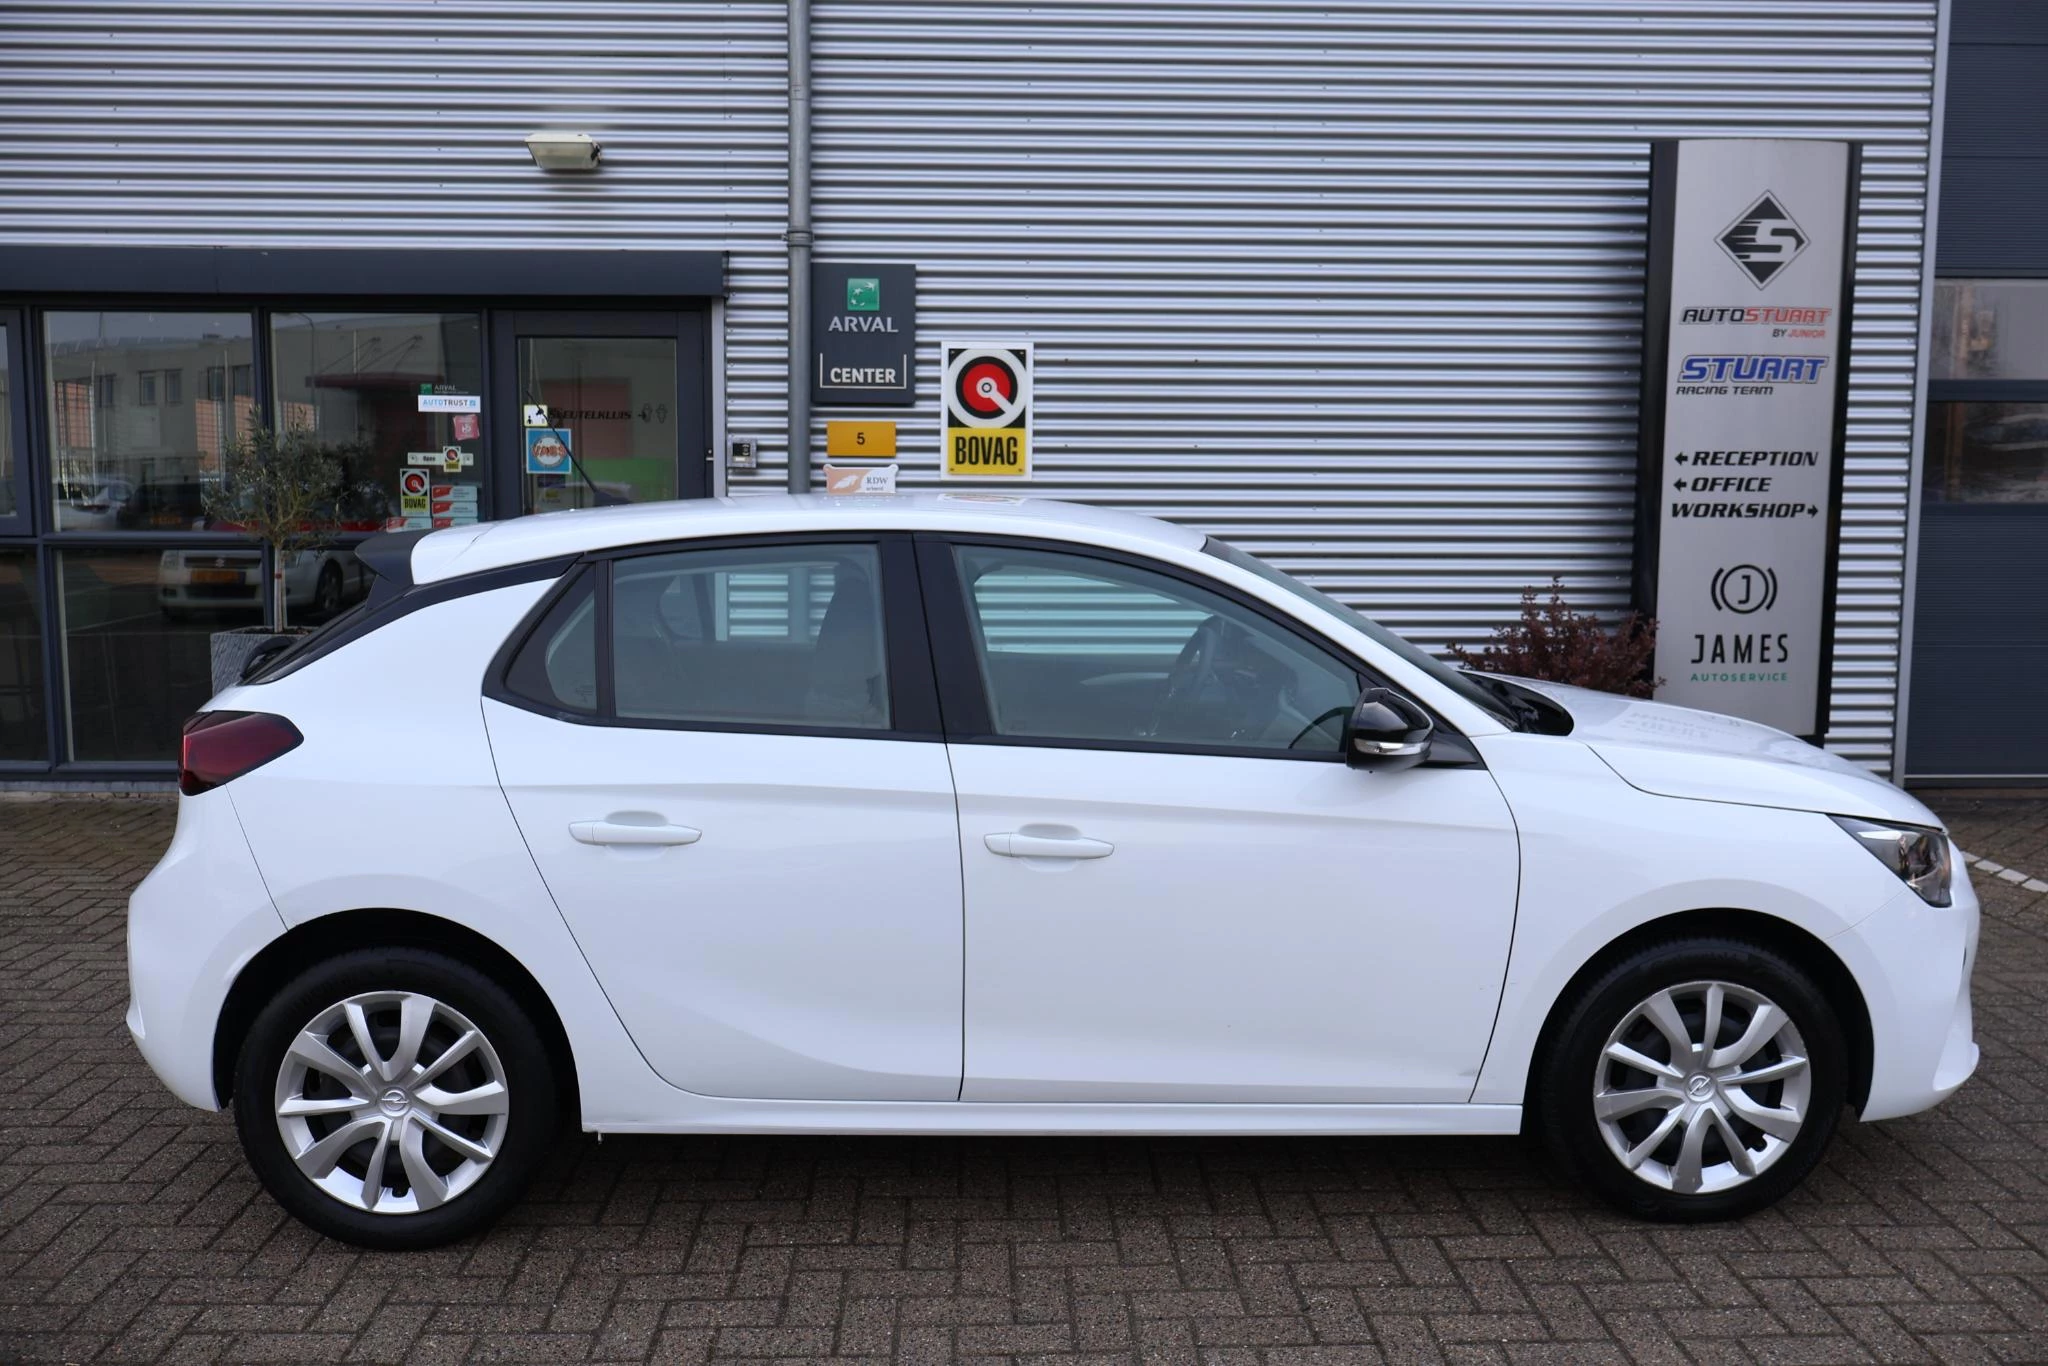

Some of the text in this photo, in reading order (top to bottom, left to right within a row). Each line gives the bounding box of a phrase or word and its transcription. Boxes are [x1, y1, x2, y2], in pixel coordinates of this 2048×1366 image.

[1681, 307, 1832, 324] AUTOSTUART
[828, 316, 899, 333] ARVAL
[1772, 328, 1826, 339] BY JUNIOR
[830, 367, 896, 384] CENTER
[1679, 356, 1829, 383] STUART
[1676, 386, 1774, 395] RACING TEAM
[423, 399, 468, 407] AUTOTRUST
[856, 432, 866, 445] 5
[955, 436, 1018, 465] BOVAG
[1691, 451, 1819, 466] RECEPTION
[866, 476, 888, 485] RDW
[1691, 477, 1773, 492] OFFICE
[404, 498, 426, 509] BOVAG
[1671, 503, 1806, 518] WORKSHOP
[1690, 634, 1789, 664] JAMES
[1690, 672, 1789, 682] AUTOSERVICE
